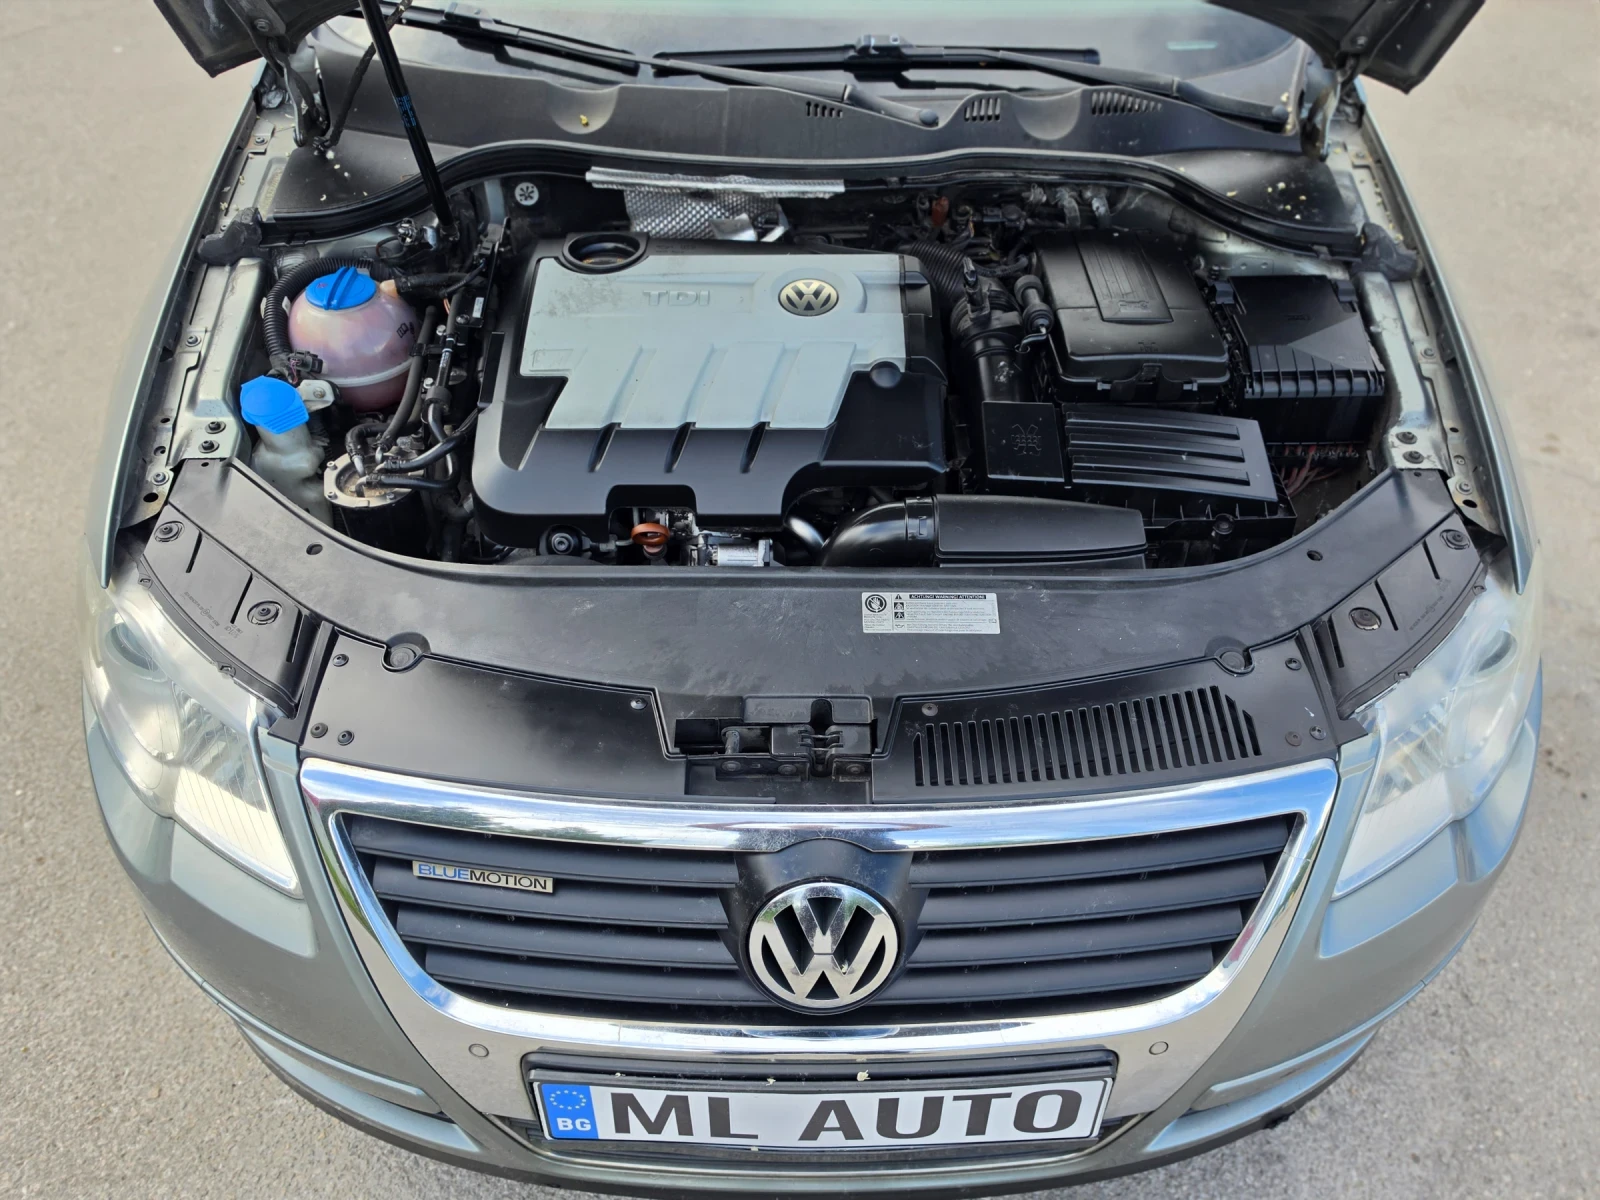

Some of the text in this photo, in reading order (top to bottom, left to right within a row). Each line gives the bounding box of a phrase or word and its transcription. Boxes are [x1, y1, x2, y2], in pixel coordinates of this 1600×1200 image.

[643, 290, 711, 306] TDI
[418, 863, 547, 890] BLUEMOTION
[556, 1117, 592, 1132] BG
[610, 1088, 1083, 1141] ML AUTO
